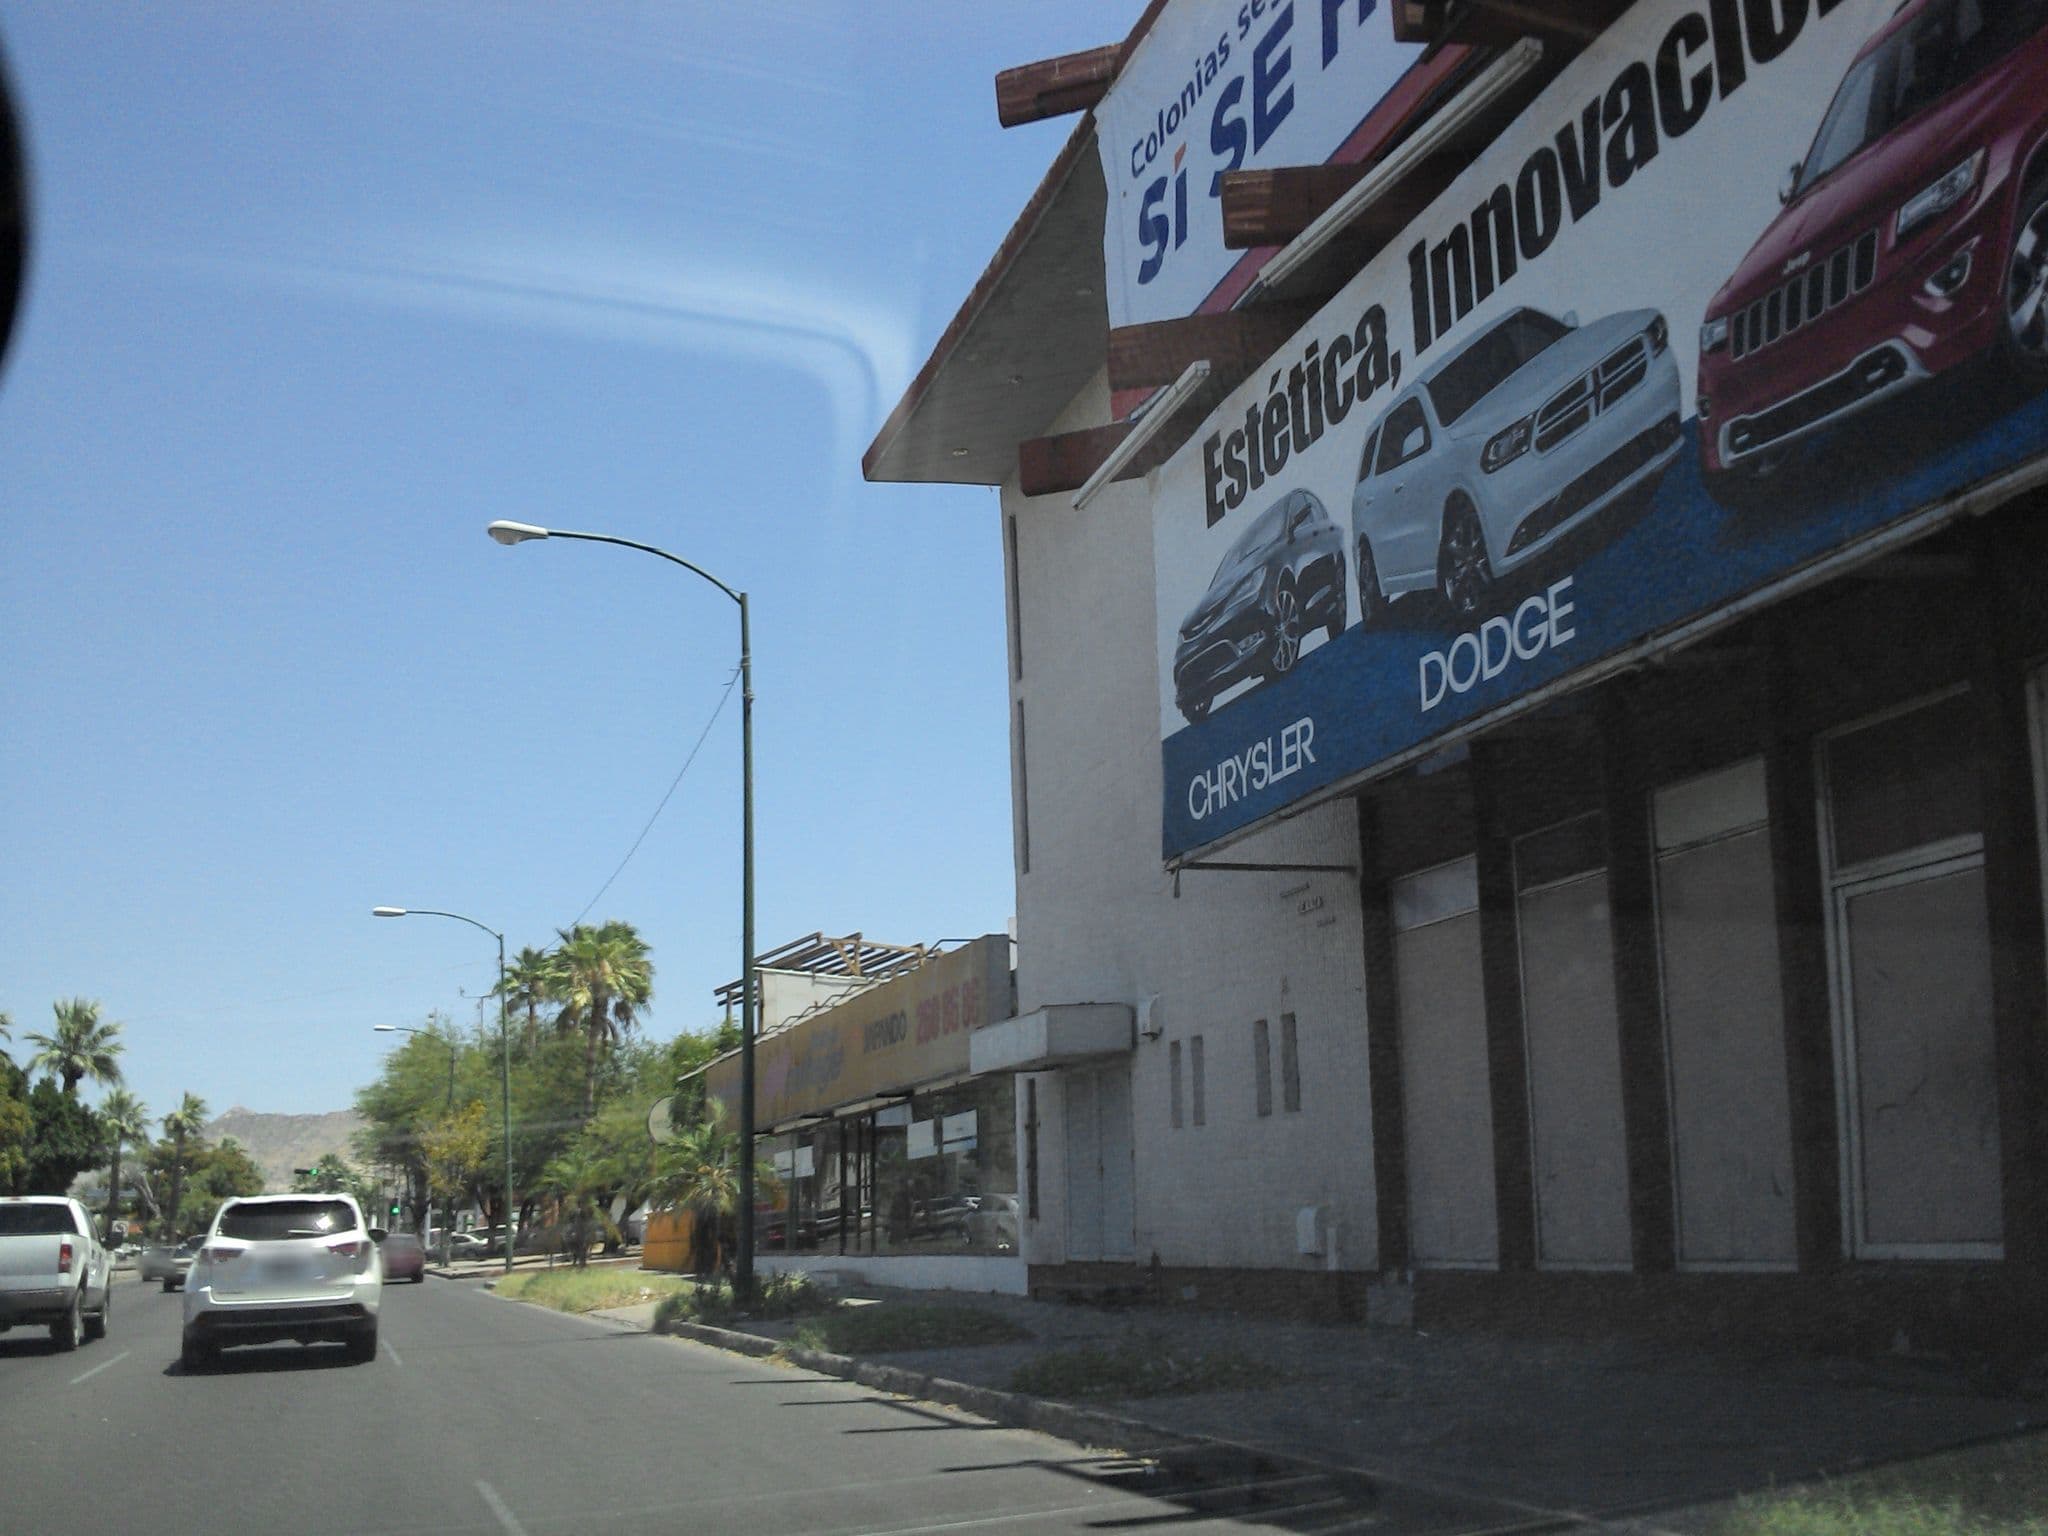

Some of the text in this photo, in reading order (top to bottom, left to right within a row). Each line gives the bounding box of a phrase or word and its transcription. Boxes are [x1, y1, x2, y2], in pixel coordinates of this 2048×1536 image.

[1131, 32, 1231, 178] Colonias
[1209, 0, 1295, 198] SE
[1203, 0, 1848, 529] Estética, Innovacio
[1419, 575, 1576, 712] DODGE
[1188, 716, 1317, 820] CHRYSLER
